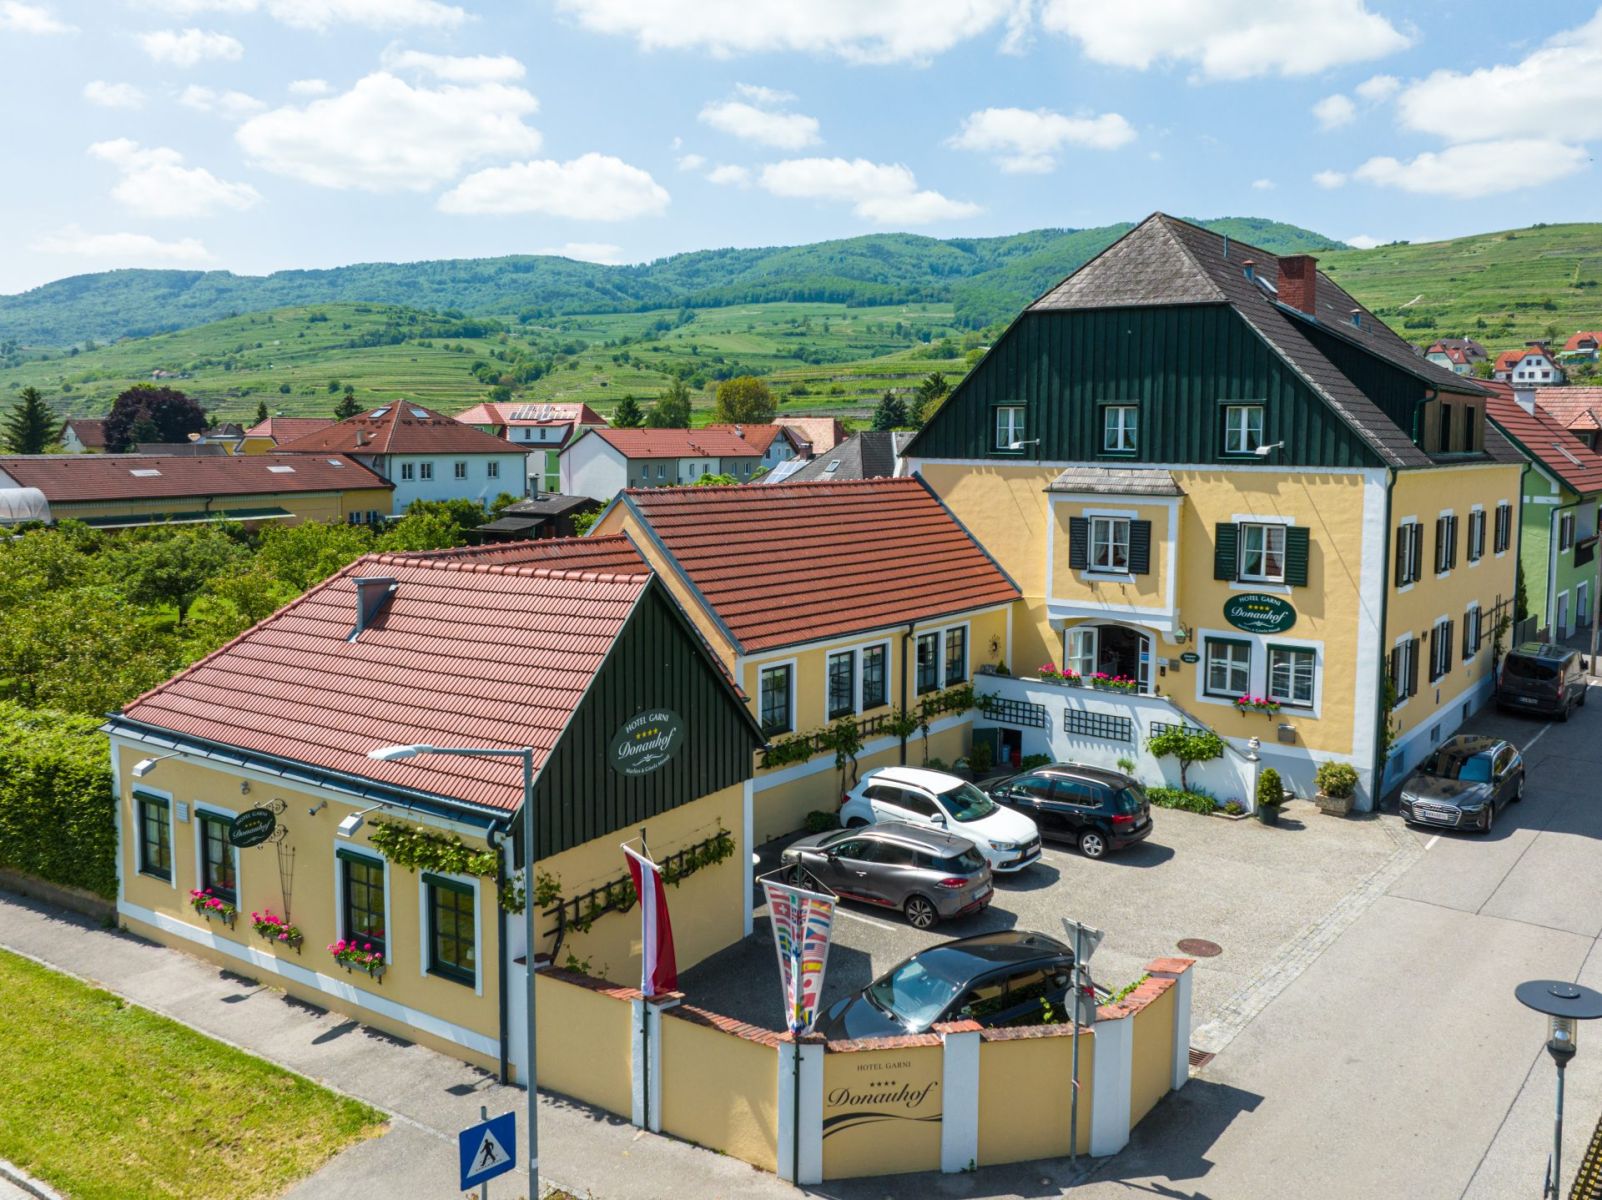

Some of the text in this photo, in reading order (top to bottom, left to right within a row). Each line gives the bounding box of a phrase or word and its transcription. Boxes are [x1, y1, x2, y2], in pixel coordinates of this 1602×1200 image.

[1239, 595, 1281, 606] HOTEL GARNI
[1231, 606, 1289, 624] Donauhof
[625, 712, 670, 734] HOTEL GARNI
[617, 727, 677, 760] Donauhof
[857, 1061, 912, 1072] HOTEL GARNI
[826, 1081, 939, 1109] Donauhof
